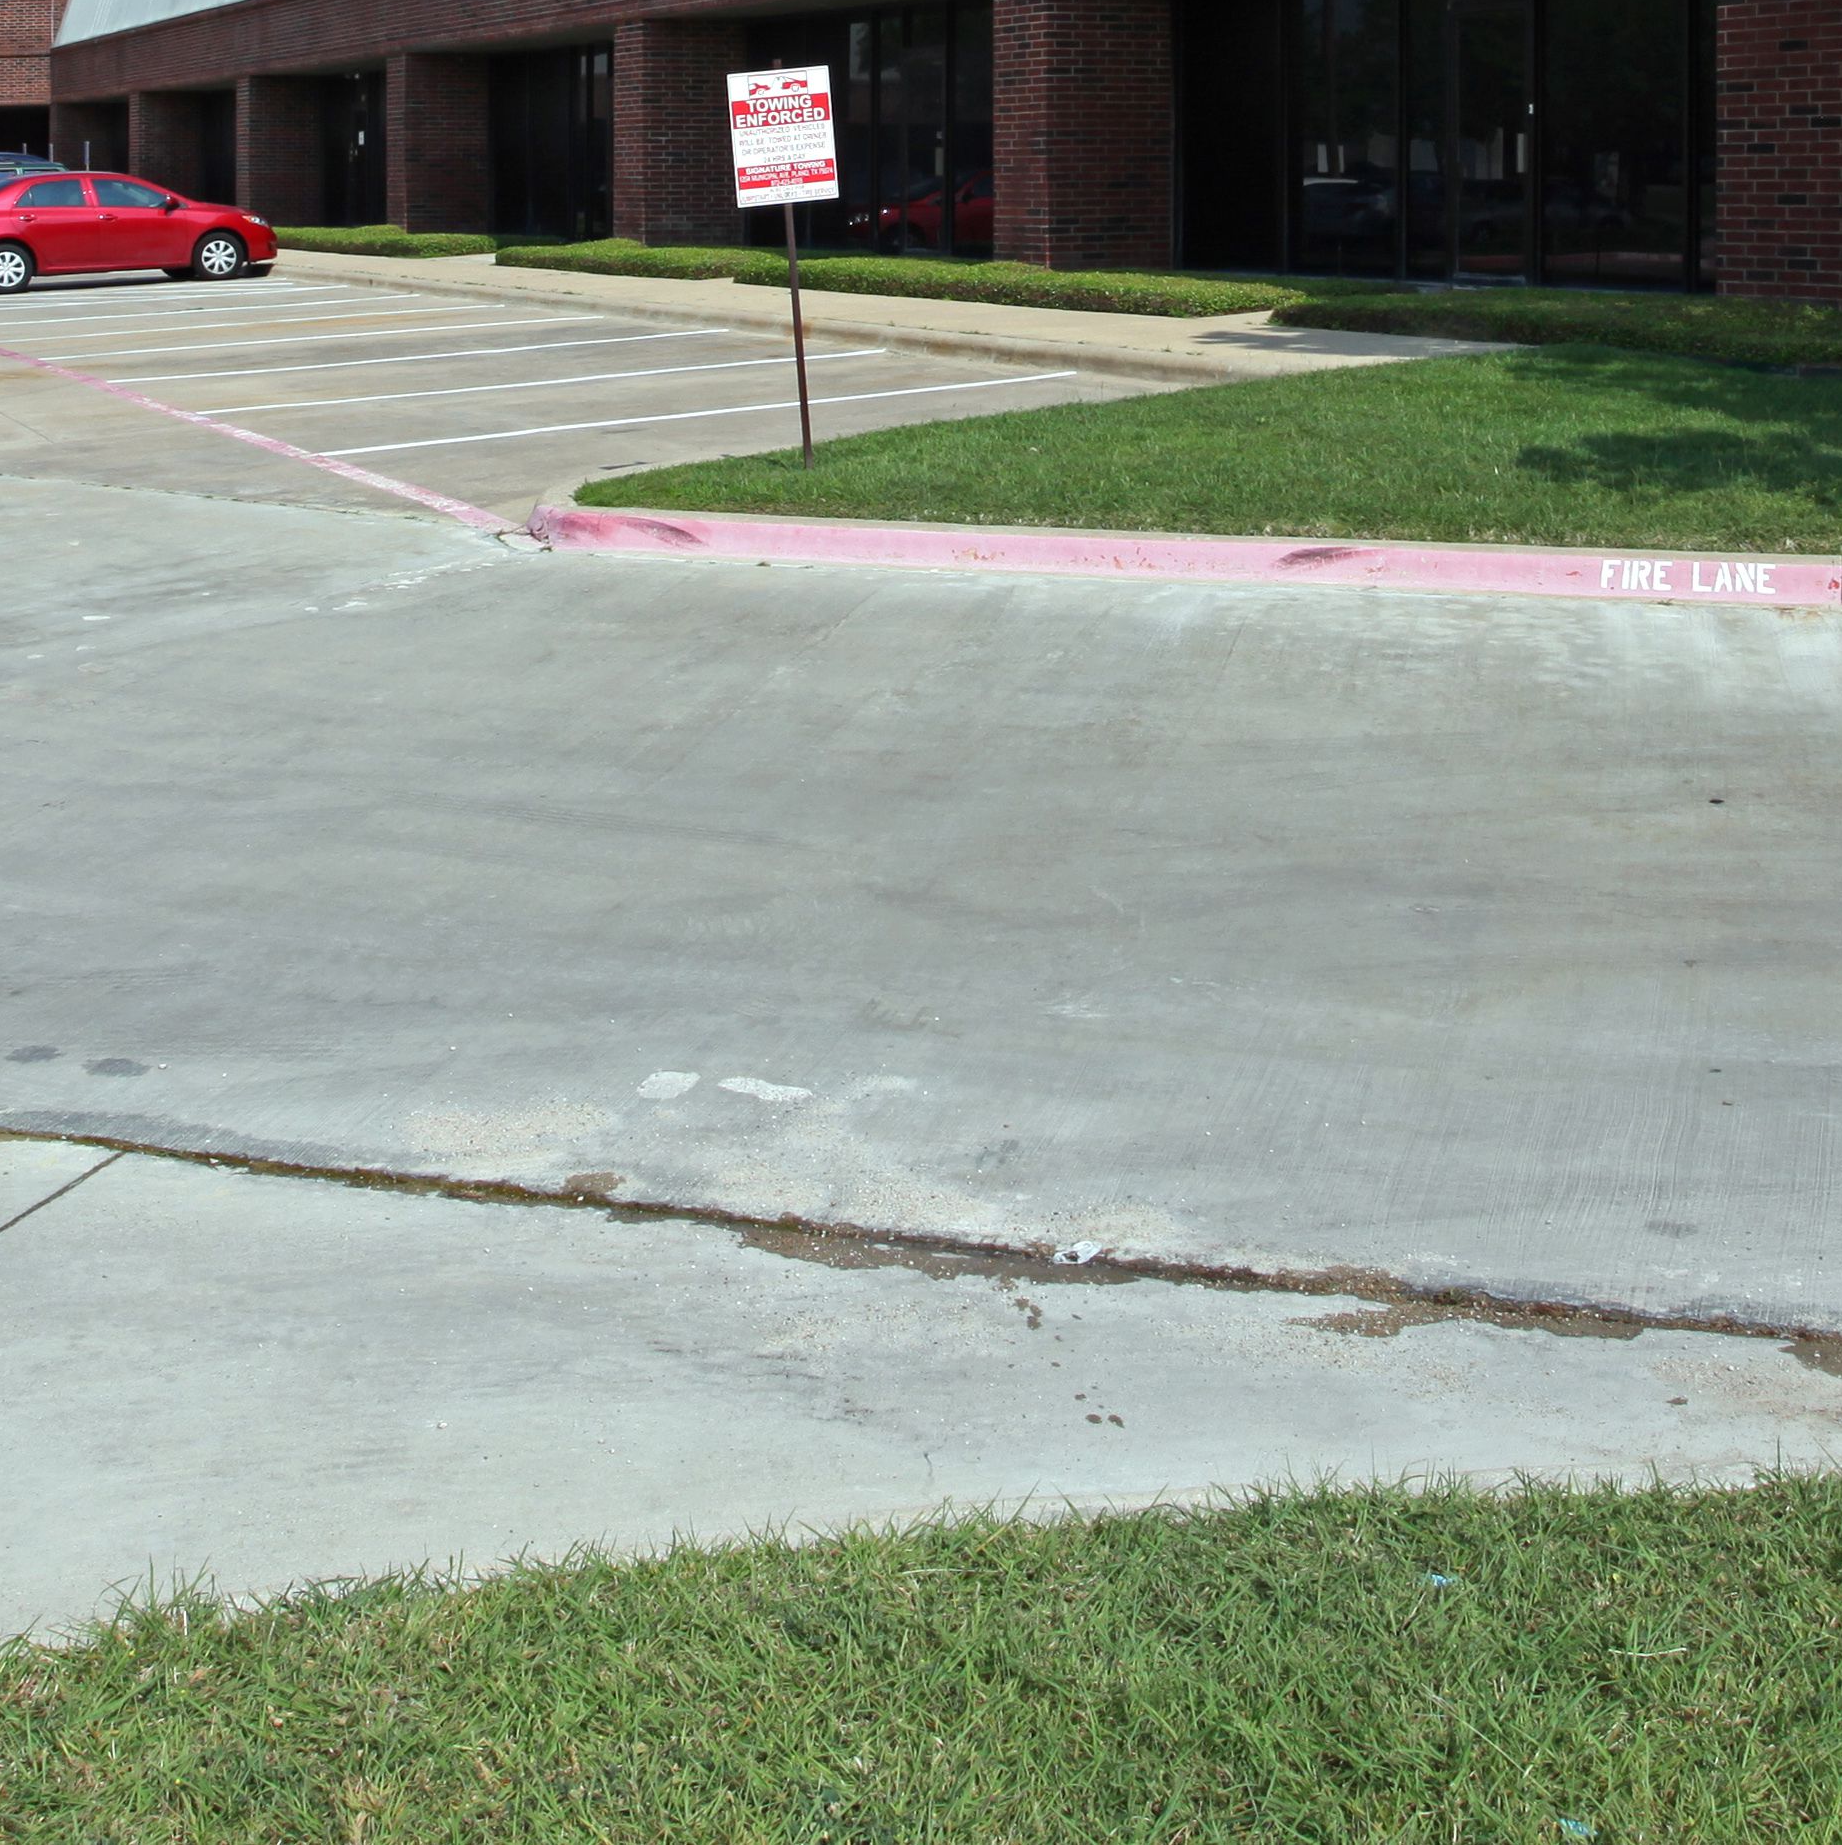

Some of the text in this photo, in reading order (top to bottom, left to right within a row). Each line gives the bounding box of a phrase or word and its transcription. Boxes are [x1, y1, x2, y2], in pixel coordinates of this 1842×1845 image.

[746, 95, 812, 113] TOWING
[735, 107, 825, 128] ENFORCED
[1600, 558, 1777, 595] FIRE LANE
